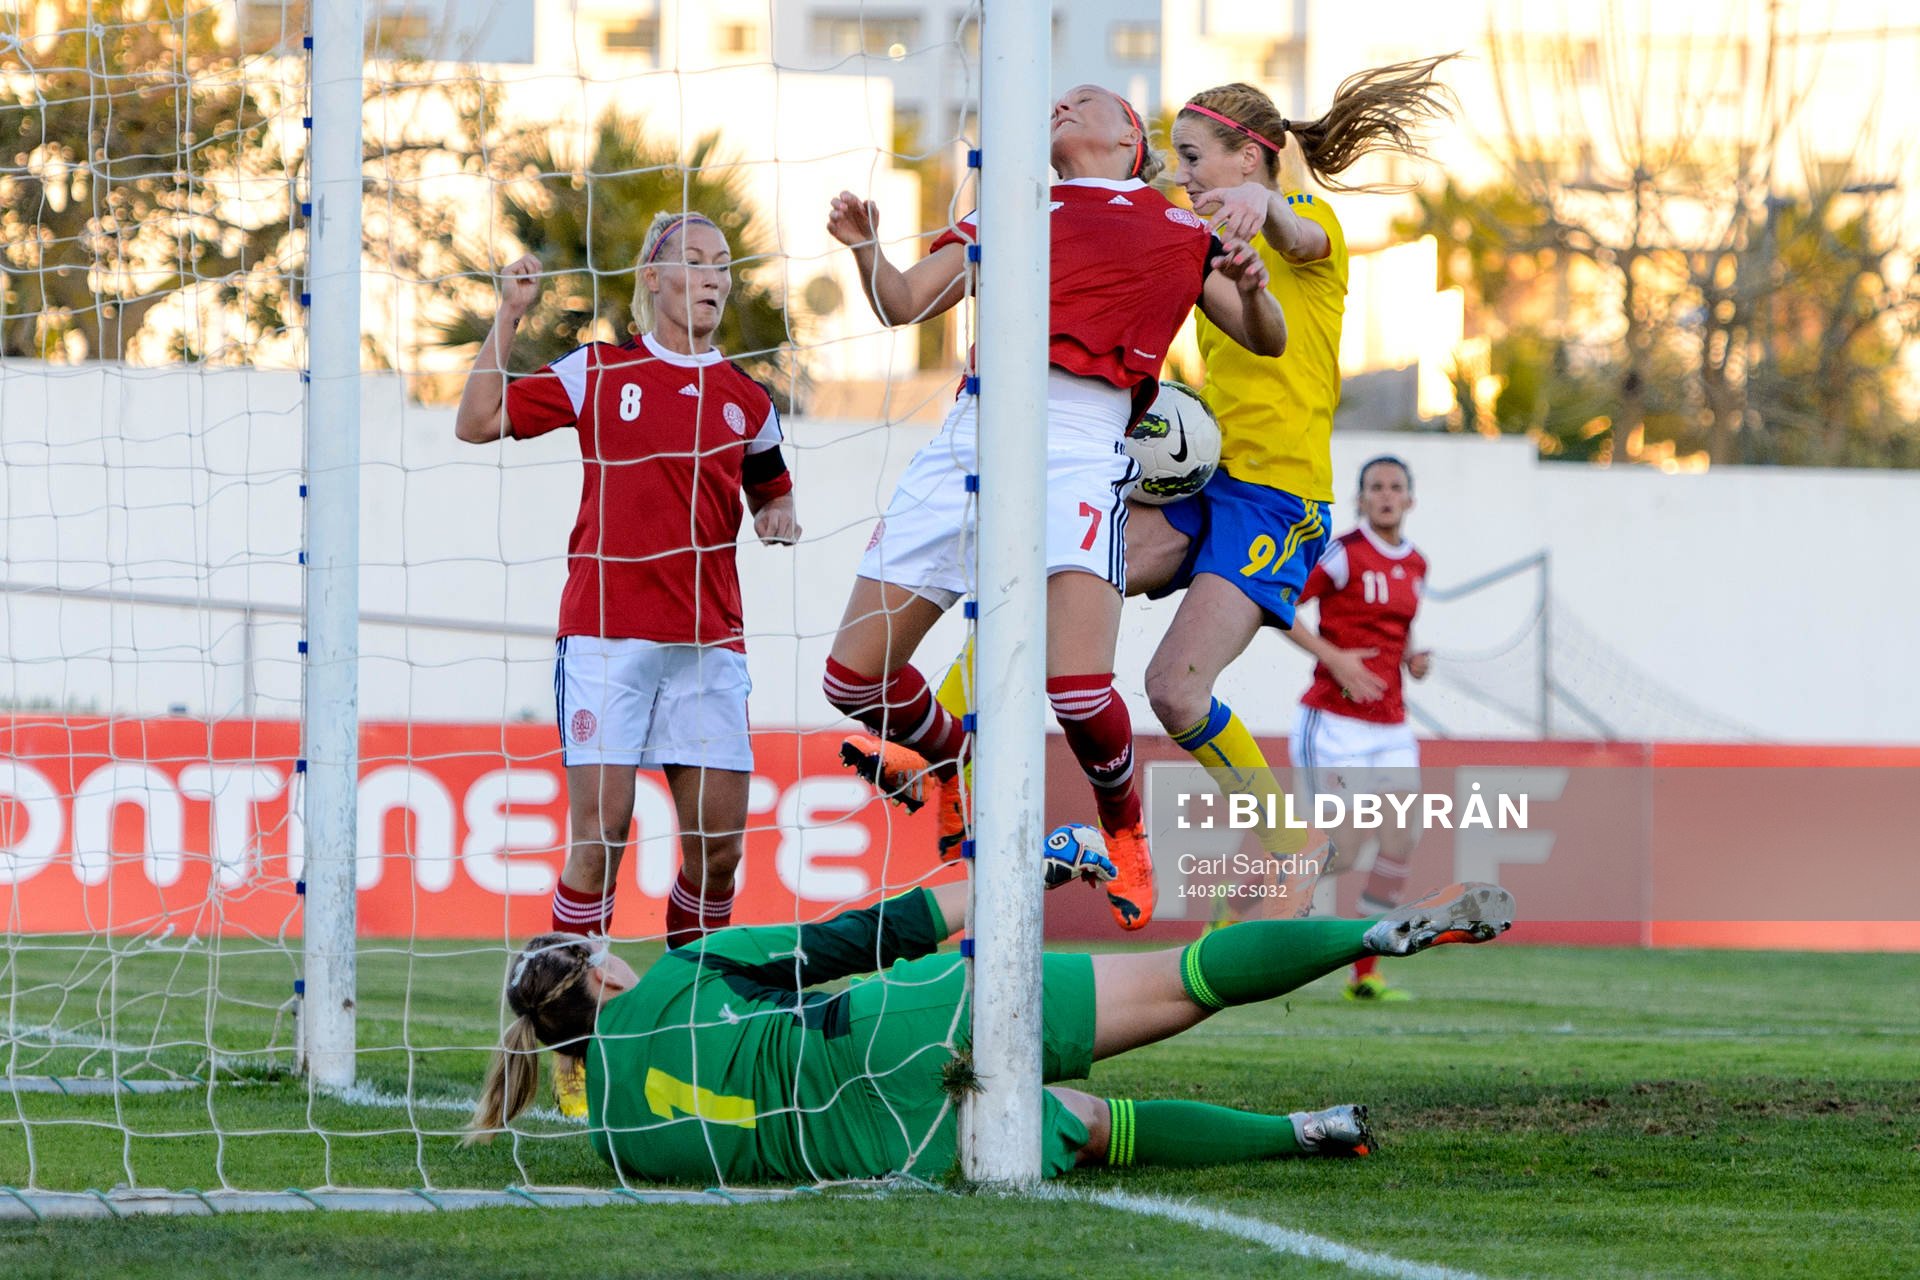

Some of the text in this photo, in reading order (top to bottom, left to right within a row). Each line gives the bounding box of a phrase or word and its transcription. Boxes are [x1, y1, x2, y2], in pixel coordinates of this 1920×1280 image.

[620, 383, 642, 421] 8
[1079, 501, 1102, 551] 7
[1239, 534, 1276, 577] 9
[1362, 570, 1389, 604] 11
[644, 1067, 756, 1129] 1
